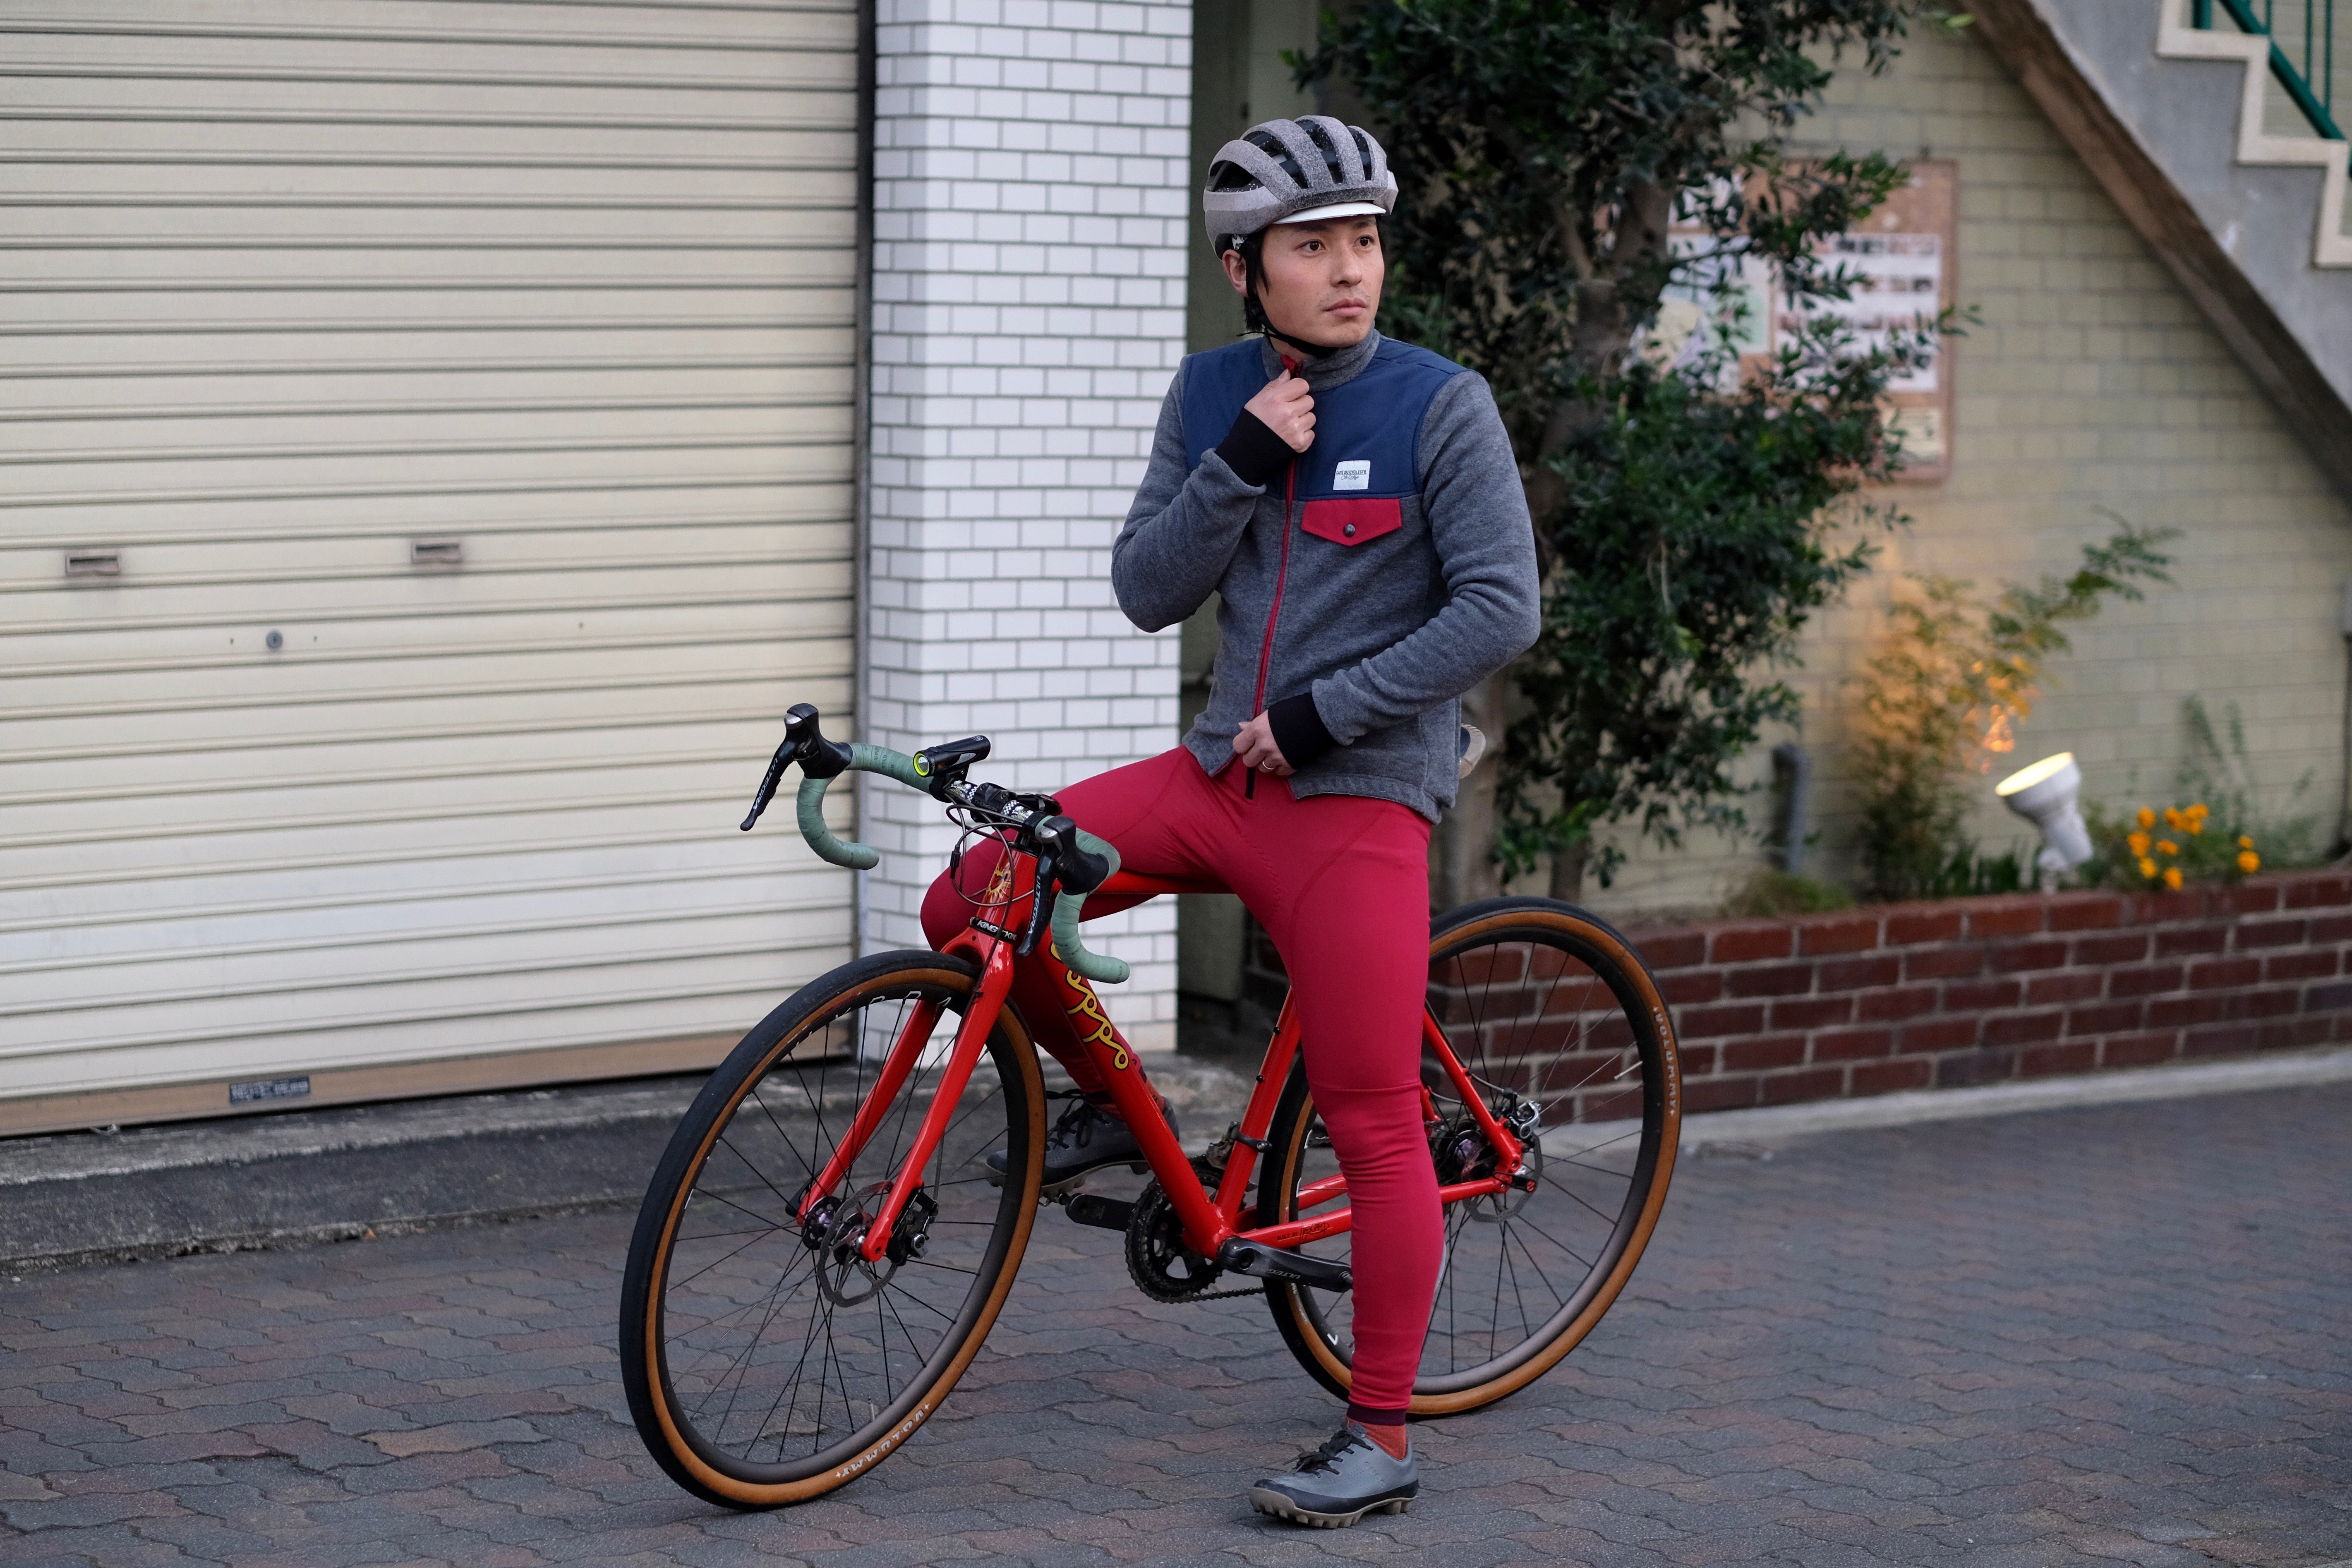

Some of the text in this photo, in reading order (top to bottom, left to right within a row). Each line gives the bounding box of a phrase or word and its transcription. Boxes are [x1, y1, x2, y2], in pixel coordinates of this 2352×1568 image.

[753, 758, 778, 810] ULTEGRA
[977, 920, 999, 933] KING
[1028, 875, 1041, 934] ULTEGRA
[1050, 942, 1129, 1070] oppo
